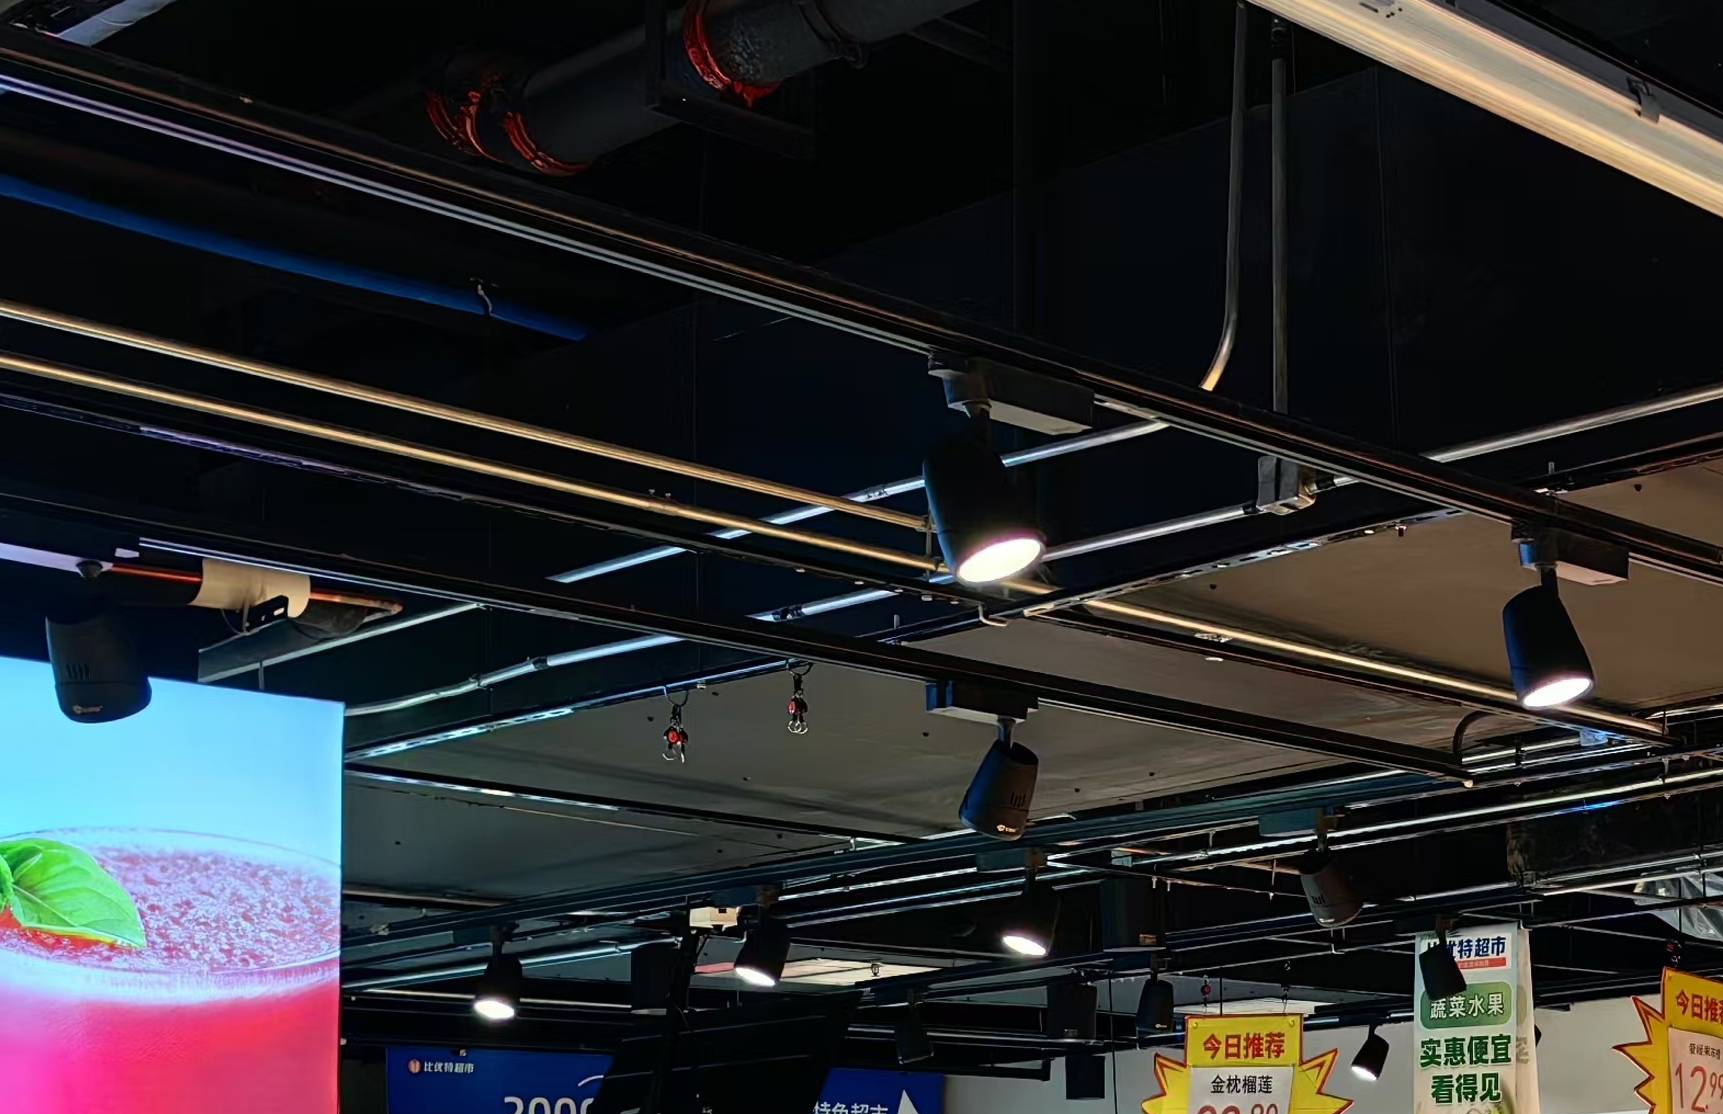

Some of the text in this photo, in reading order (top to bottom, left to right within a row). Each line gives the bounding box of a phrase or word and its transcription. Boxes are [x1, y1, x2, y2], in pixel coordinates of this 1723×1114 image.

[1426, 936, 1506, 959] 特超市
[1430, 993, 1505, 1020] 蔬菜水果
[1203, 1032, 1286, 1060] 今日推荐
[1420, 1034, 1511, 1067] 实惠便宜
[1210, 1075, 1273, 1094] 金枕榴莲
[1431, 1073, 1501, 1104] 看得见
